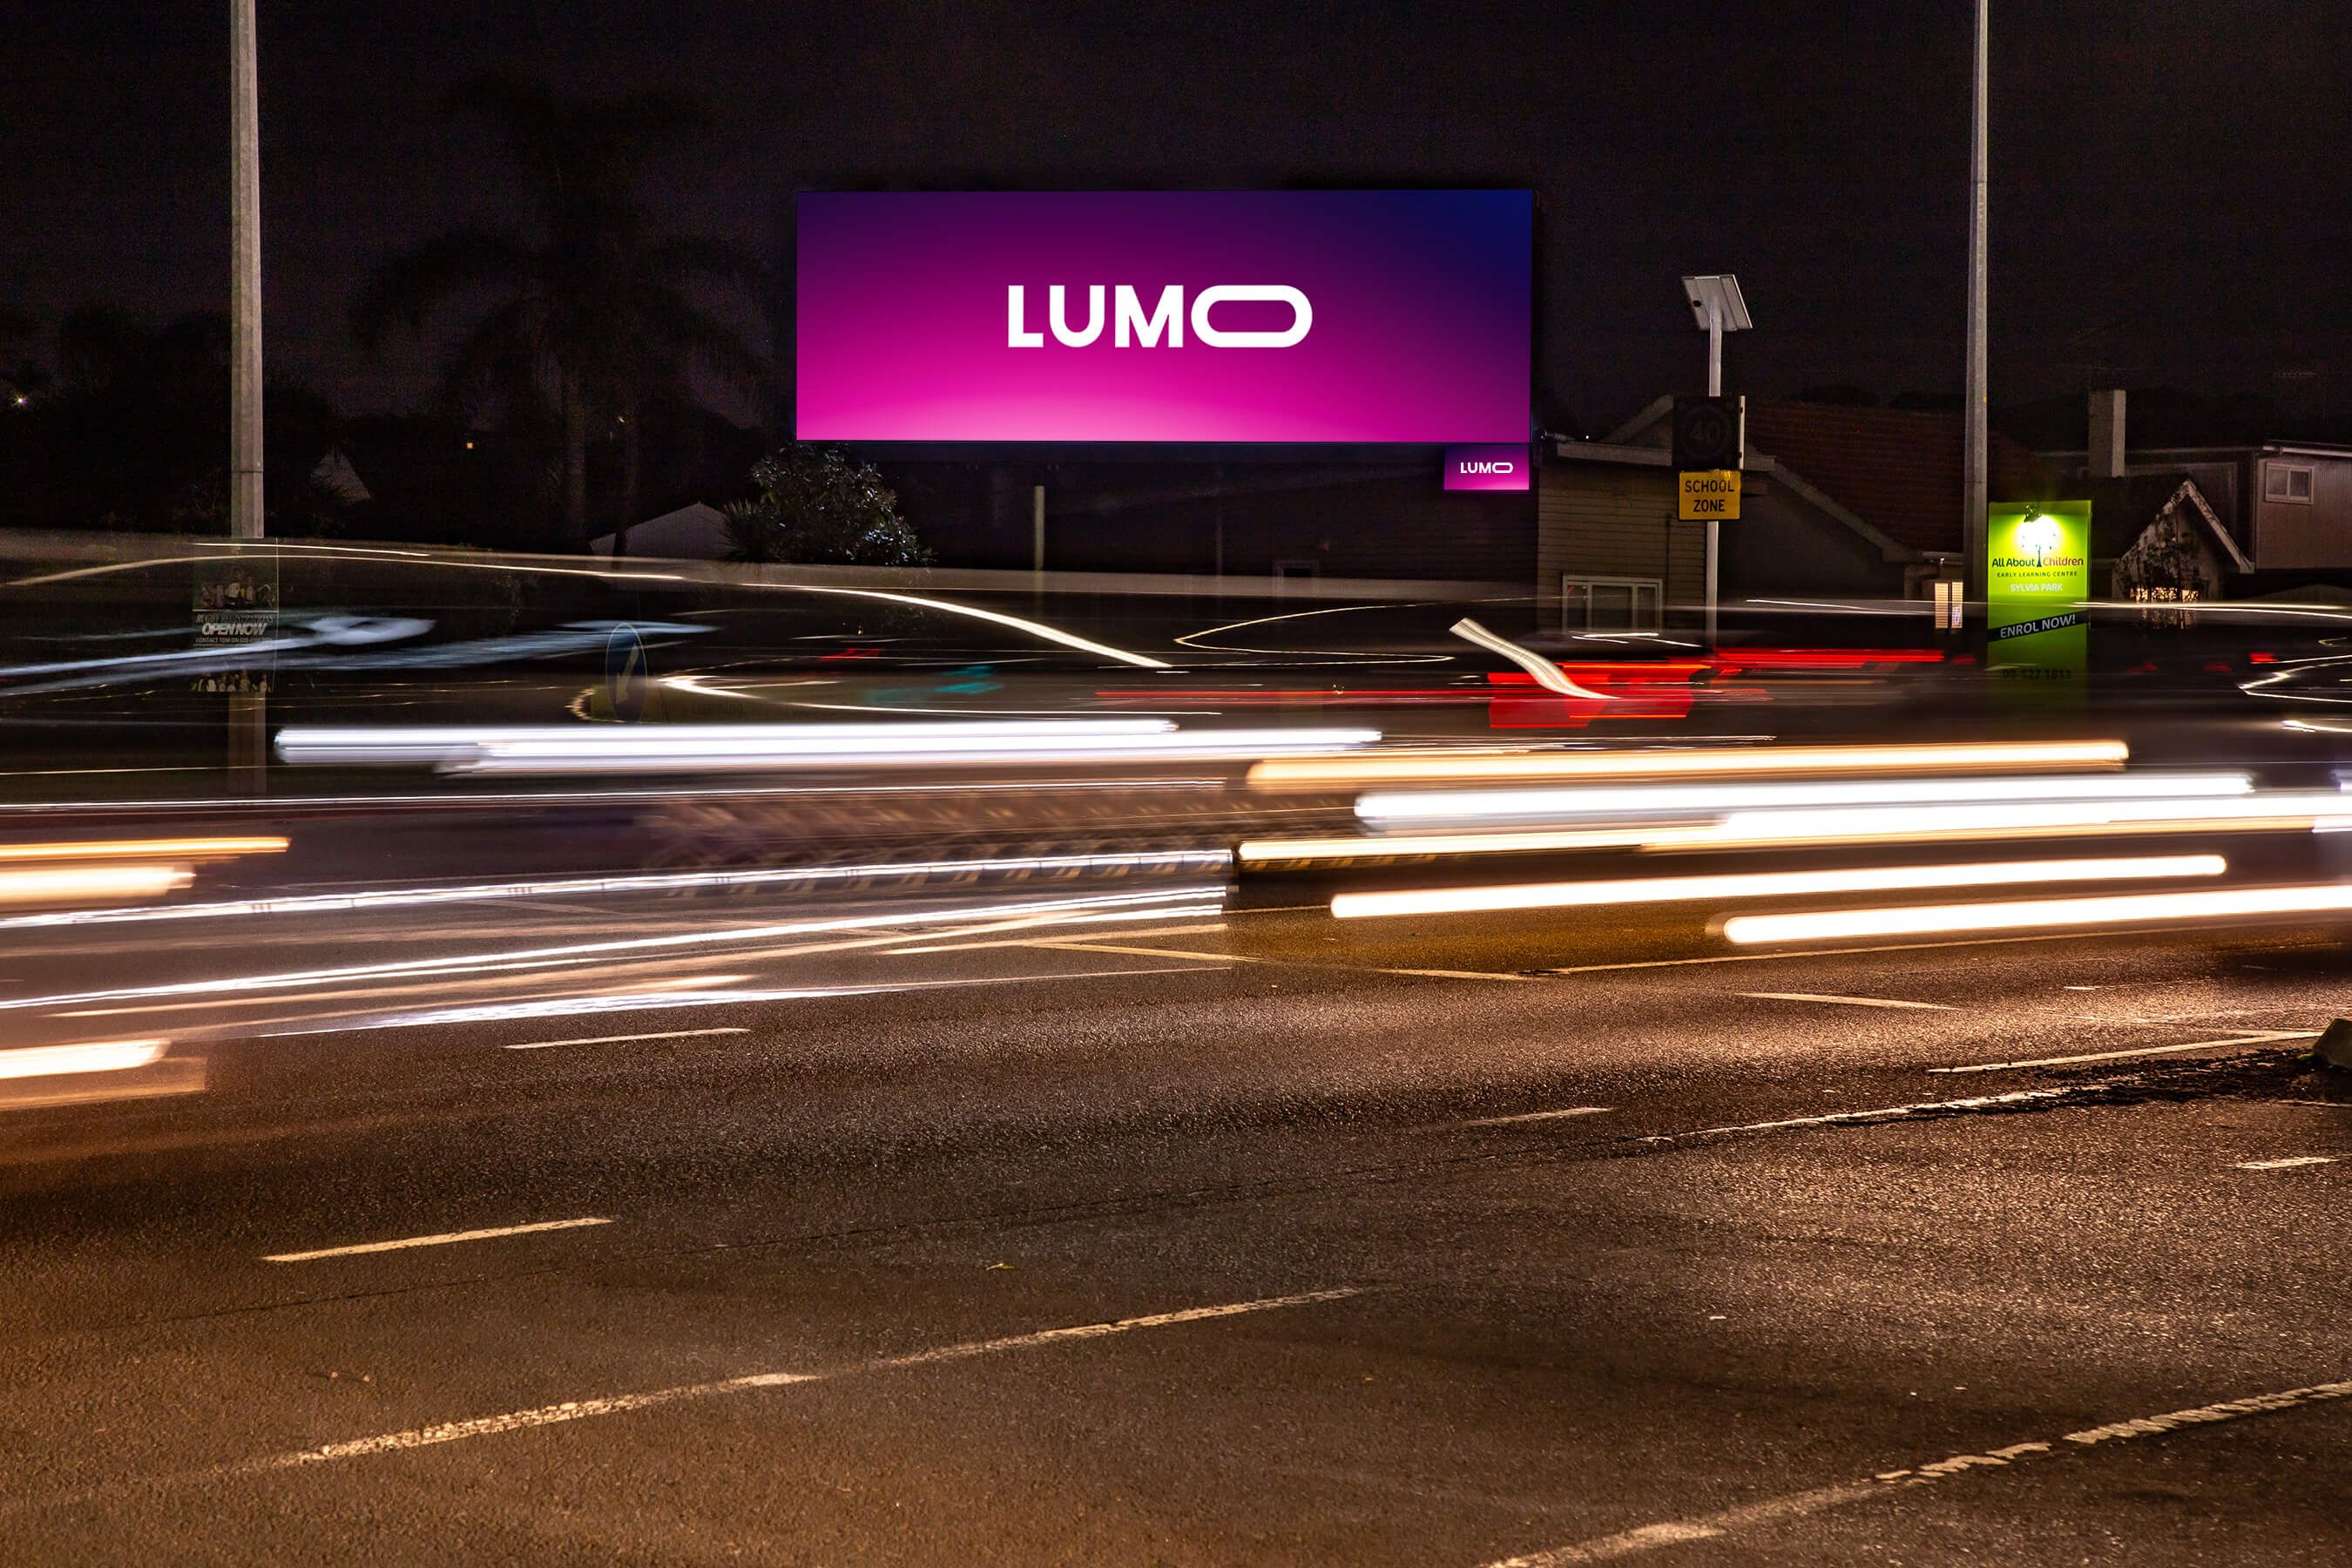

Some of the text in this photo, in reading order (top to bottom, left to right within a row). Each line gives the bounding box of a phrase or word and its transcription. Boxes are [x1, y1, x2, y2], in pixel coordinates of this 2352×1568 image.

[1008, 285, 1313, 348] LUMO
[1460, 462, 1513, 473] LUMO
[1685, 480, 1734, 493] SCHOOL
[1693, 499, 1726, 512] ZONE
[1991, 557, 2084, 567] All About Children
[2010, 583, 2063, 592] SYLVIA PARK
[201, 622, 267, 635] OPEN NOW
[2000, 613, 2076, 639] ENROL NOW!
